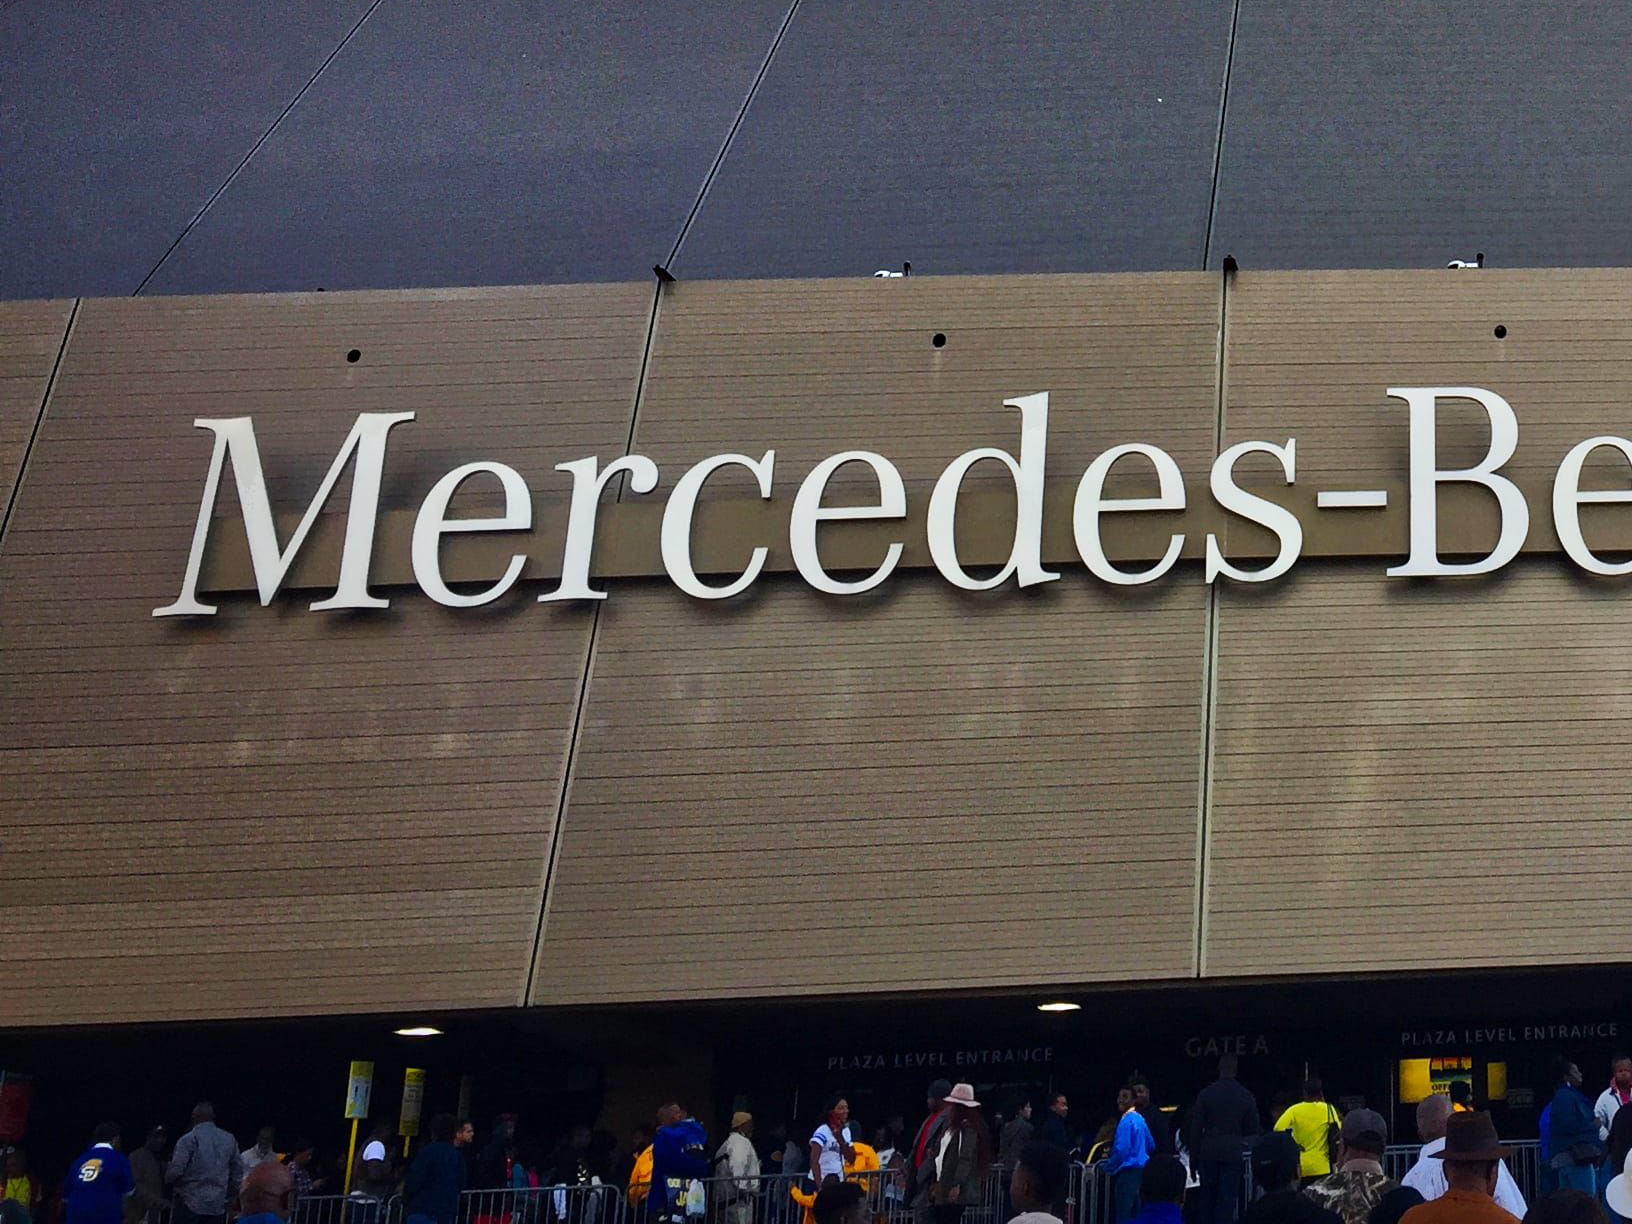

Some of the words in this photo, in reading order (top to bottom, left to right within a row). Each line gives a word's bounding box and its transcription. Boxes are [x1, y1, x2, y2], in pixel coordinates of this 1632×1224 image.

[1184, 1034, 1248, 1057] GATE
[1252, 1034, 1270, 1056] A
[1401, 1030, 1457, 1047] PLAZA
[1465, 1026, 1517, 1045] LEVEL
[1523, 1021, 1618, 1041] ENTRANCE
[826, 1055, 886, 1071] PLAZA
[893, 1051, 948, 1069] LEVEL
[955, 1047, 1054, 1066] ENTRANCE
